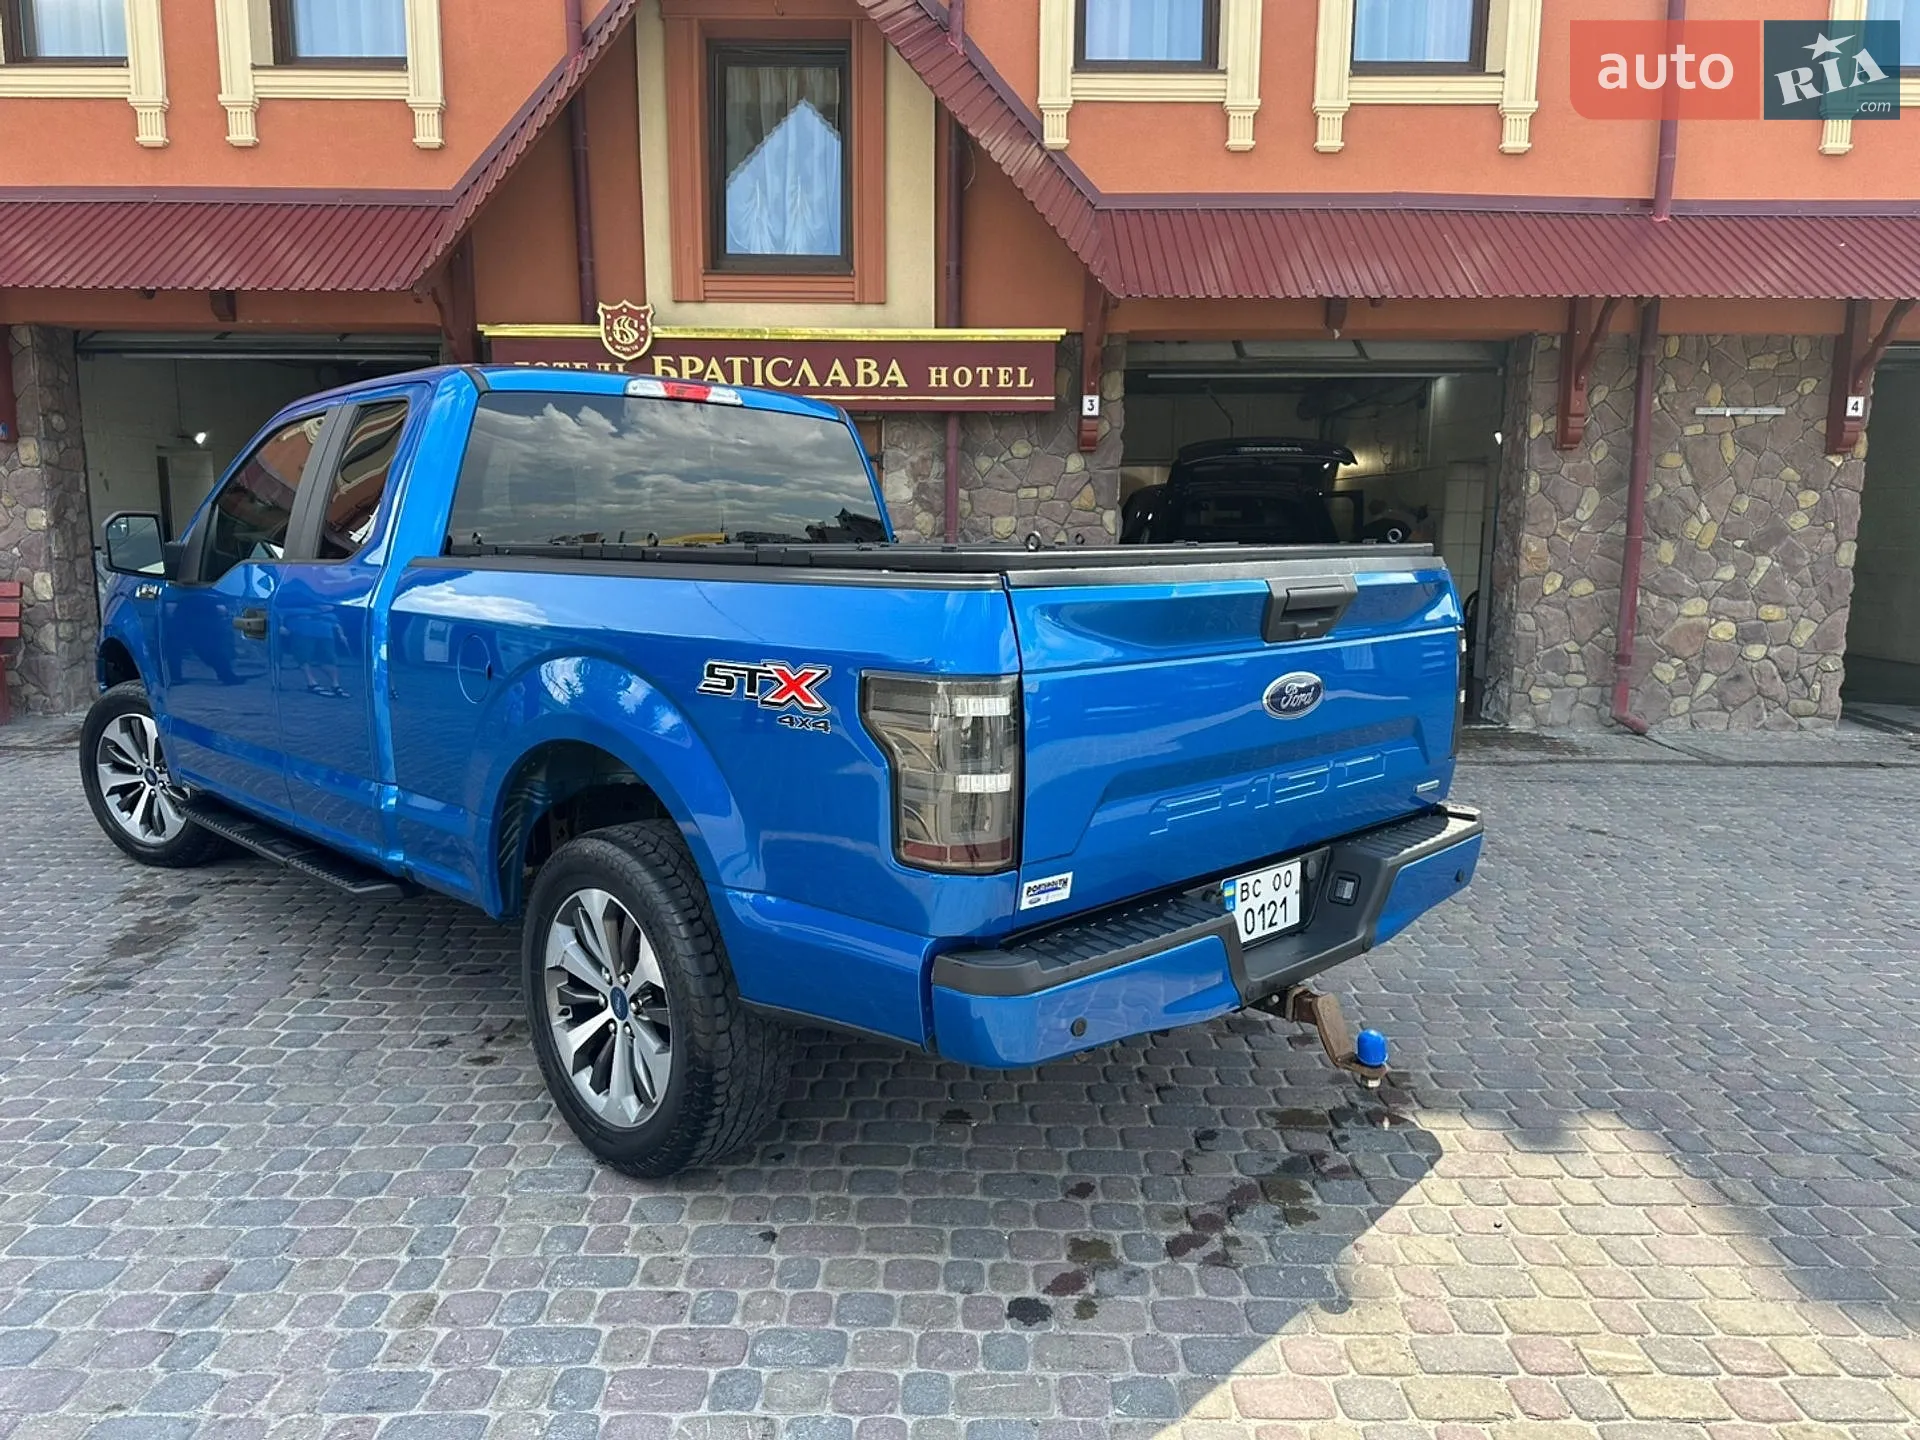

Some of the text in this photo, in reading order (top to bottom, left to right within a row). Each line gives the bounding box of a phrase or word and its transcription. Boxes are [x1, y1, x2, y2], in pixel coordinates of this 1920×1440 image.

[652, 356, 909, 388] БРАТІСЛАВА
[927, 366, 1035, 388] HOTEL
[1087, 399, 1095, 411] 3
[1851, 400, 1859, 412] 4
[697, 659, 832, 716] STX
[1240, 869, 1292, 902] BC 00
[1244, 896, 1287, 935] 0121
